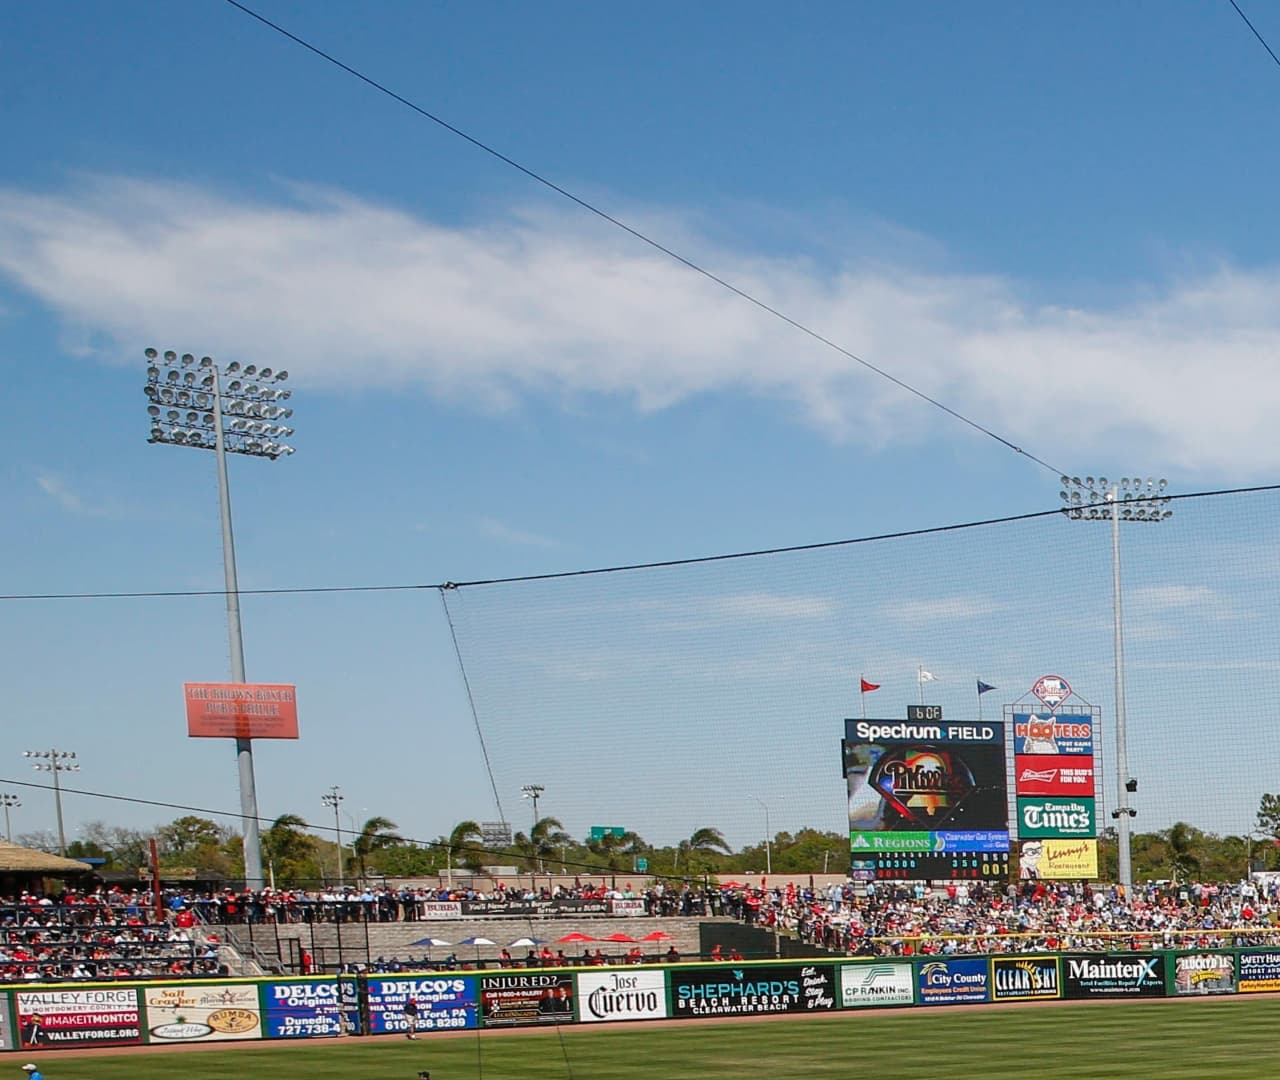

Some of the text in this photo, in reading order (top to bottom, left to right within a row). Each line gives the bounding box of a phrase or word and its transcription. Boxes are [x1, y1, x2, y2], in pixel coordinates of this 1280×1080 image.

[857, 723, 994, 741] Spectrum FIELD
[1016, 723, 1091, 739] HOOTERS
[1024, 805, 1090, 829] Times
[874, 837, 931, 848] REGIONS
[1240, 954, 1266, 964] SAFETY
[1069, 958, 1159, 985] MaintenX
[482, 976, 558, 989] INJURED?
[610, 974, 638, 992] Jose
[931, 973, 987, 986] City County
[995, 968, 1030, 991] CLEAR
[161, 990, 185, 998] Salt
[381, 980, 465, 995] DELCO'S
[678, 980, 800, 1000] SHEPHARD'S
[845, 987, 859, 996] CP
[860, 986, 896, 995] RANKIN
[20, 991, 135, 1005] VALLEY FORGE
[287, 993, 456, 1008] Original and Hoagies
[588, 986, 658, 1019] Cuervo
[678, 994, 800, 1009] BEACH RESORT
[452, 1009, 467, 1017] PA
[692, 1003, 788, 1015] CLEARWATER BEACH
[45, 1013, 138, 1026] #MAKEITMONTCO
[212, 1011, 253, 1021] RUMBA
[285, 1016, 336, 1026] Dunedin,
[47, 1029, 140, 1041] VALLEYFORGE.ORG
